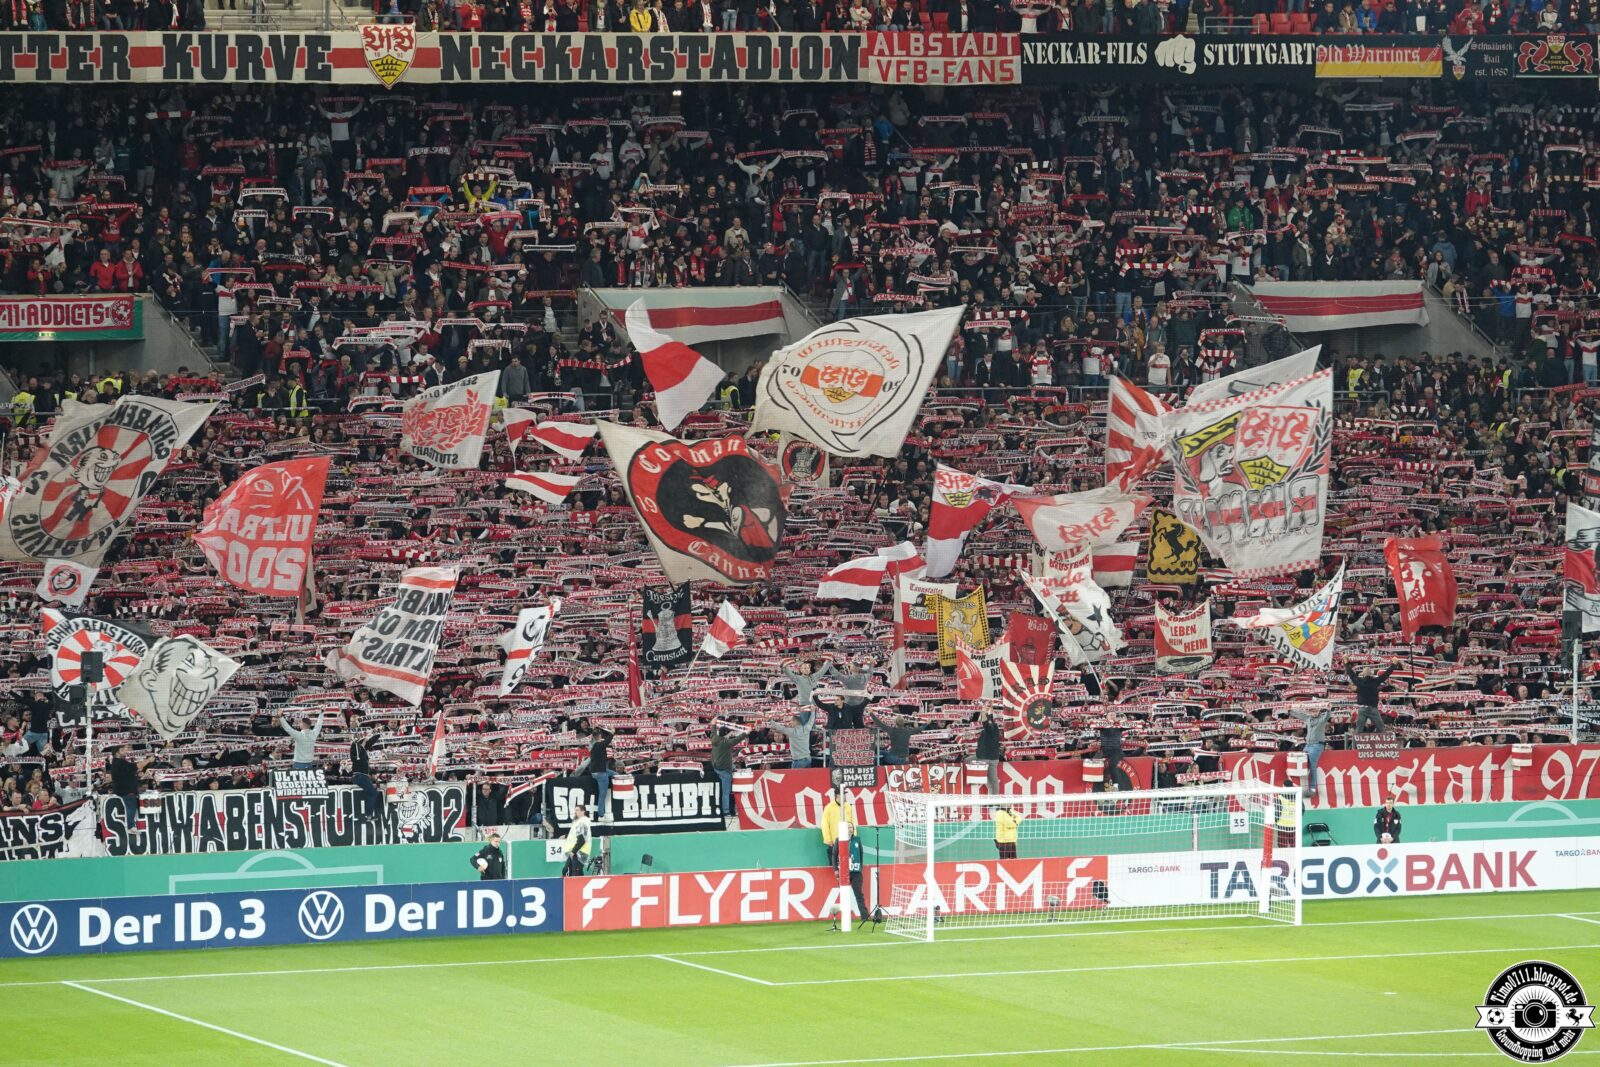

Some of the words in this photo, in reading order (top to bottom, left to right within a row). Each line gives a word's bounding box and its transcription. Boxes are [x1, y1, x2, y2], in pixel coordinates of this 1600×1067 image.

[873, 33, 1019, 57] ALBSTADT
[1022, 42, 1147, 65] NECKAR-FILS
[1203, 43, 1315, 66] STUTTGART
[1316, 43, 1342, 64] Old
[1346, 42, 1421, 65] Warriors
[163, 34, 332, 81] KURVE
[440, 34, 861, 81] NECKARSTADION
[876, 59, 1015, 84] VFB-FANS
[1170, 625, 1197, 637] LEBEN
[1184, 638, 1208, 652] HEIM
[538, 751, 579, 759] Commando
[1011, 749, 1047, 757] Commando
[274, 769, 326, 782] ULTRAS
[889, 767, 922, 788] CC
[929, 764, 962, 784] 97
[1540, 748, 1600, 800] 97
[276, 780, 327, 789] BEDEUTET
[277, 788, 329, 797] WIDERSTAND
[622, 782, 721, 819] BLEIBT!
[1233, 818, 1246, 828] 35
[550, 845, 563, 856] 34
[1159, 864, 1181, 873] BANK
[1405, 850, 1538, 893] BANK
[79, 907, 161, 947] Der
[174, 900, 266, 942] ID.3
[365, 892, 446, 934] Der
[457, 887, 546, 930] ID.3
